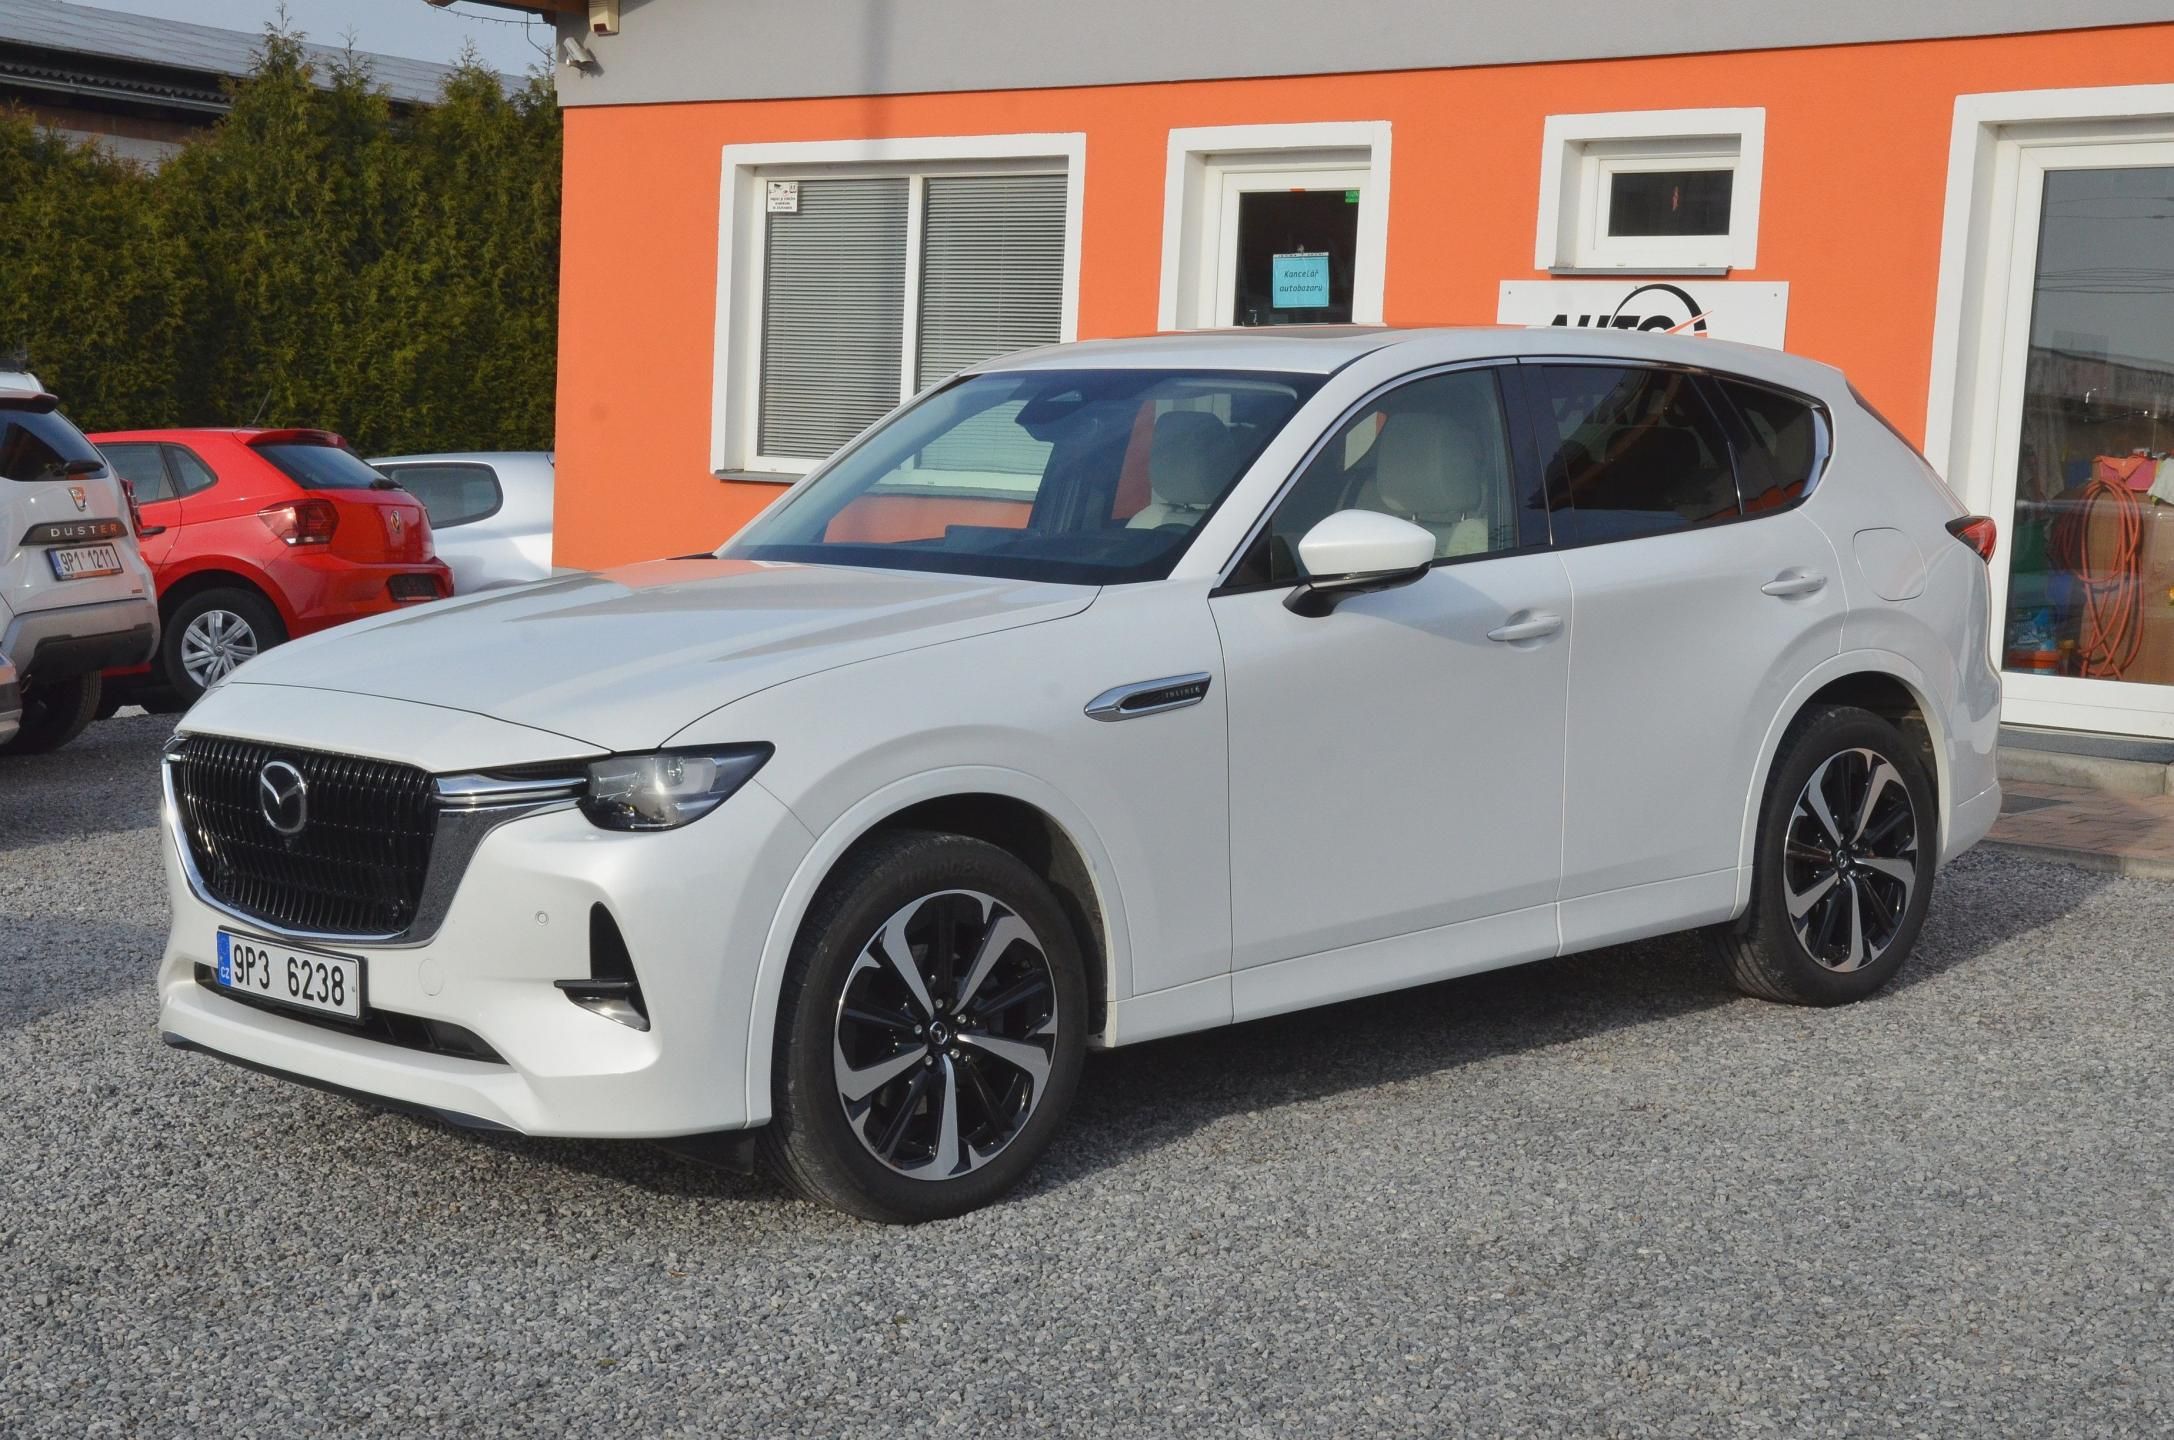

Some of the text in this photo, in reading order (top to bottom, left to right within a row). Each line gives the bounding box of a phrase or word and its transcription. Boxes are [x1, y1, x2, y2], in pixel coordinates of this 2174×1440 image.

[50, 523, 117, 537] DUSTER
[234, 943, 344, 1006] 9P3 6238
